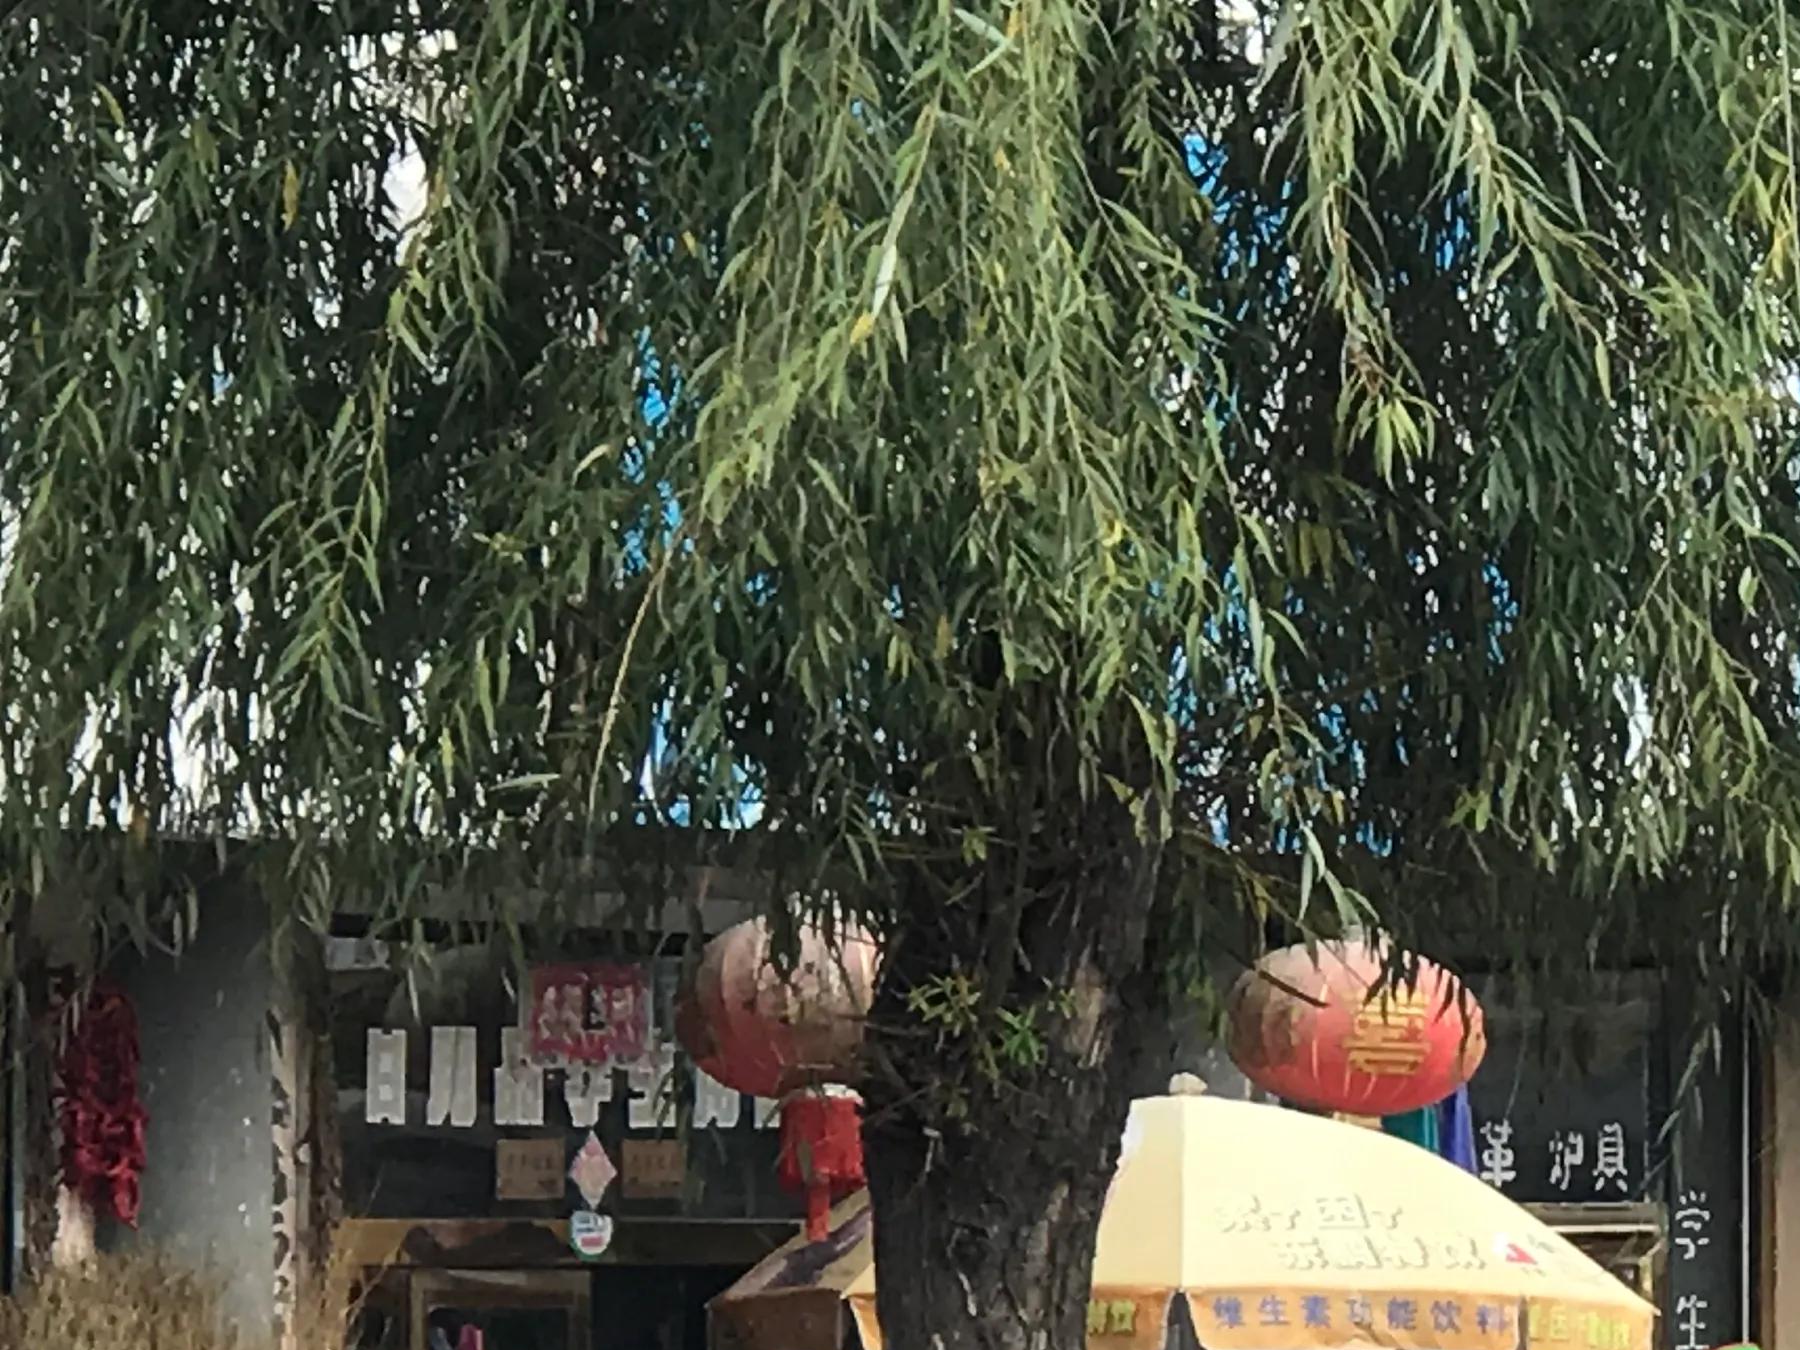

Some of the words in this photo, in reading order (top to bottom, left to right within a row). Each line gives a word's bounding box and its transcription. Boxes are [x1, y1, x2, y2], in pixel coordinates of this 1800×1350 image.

[1213, 1294, 1513, 1335] 维生素功能饮料
